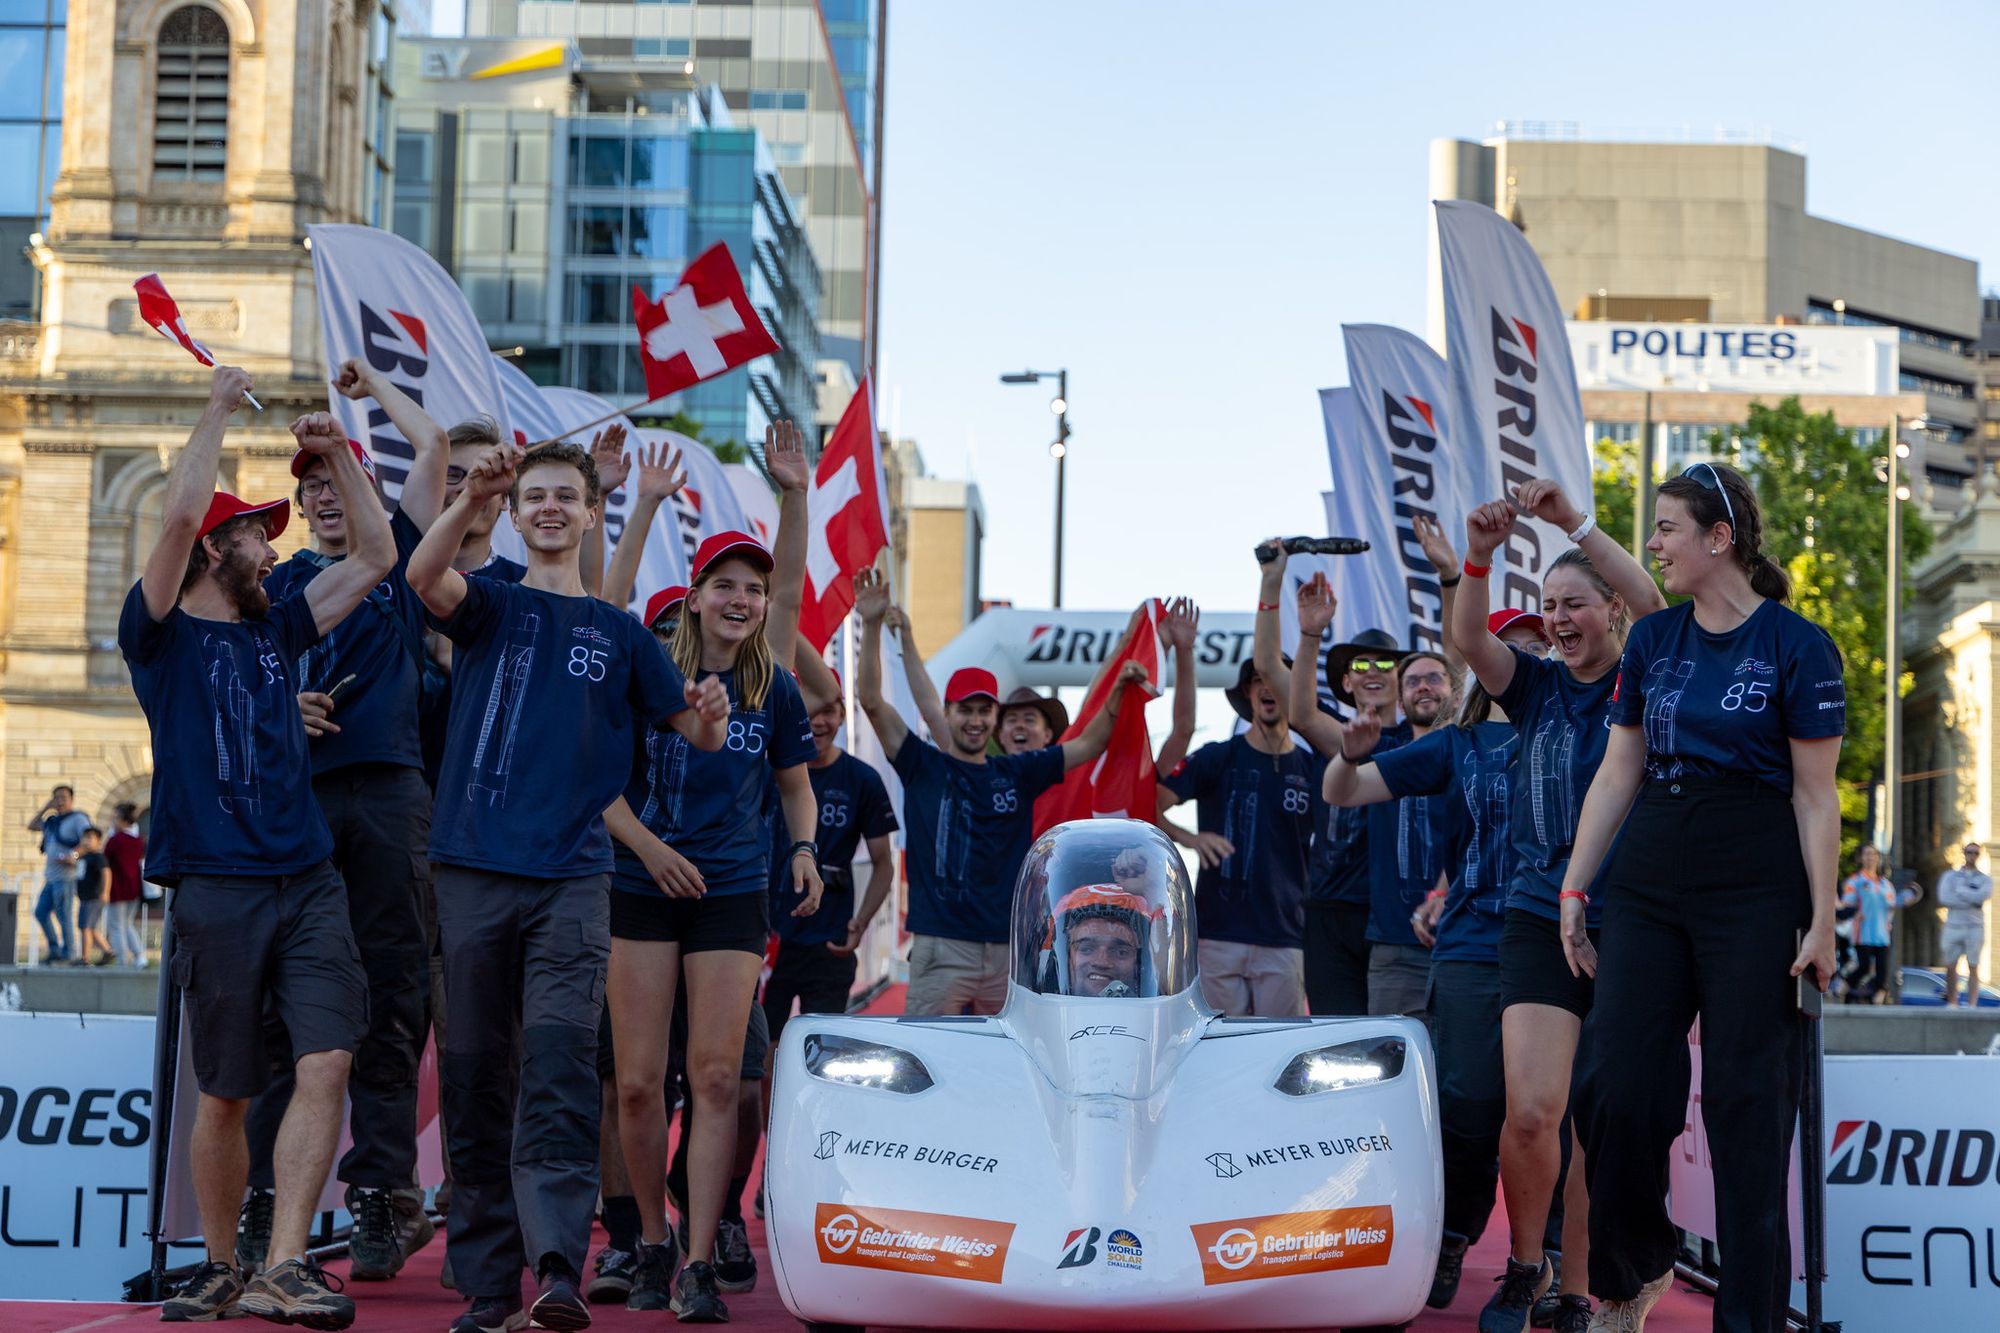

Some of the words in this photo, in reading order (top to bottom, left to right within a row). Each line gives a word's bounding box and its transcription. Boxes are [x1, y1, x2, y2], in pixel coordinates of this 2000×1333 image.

[420, 46, 470, 79] EY
[1611, 330, 1797, 360] POLITES
[568, 646, 608, 681] 85
[1721, 681, 1771, 712] 85
[726, 721, 765, 753] 85
[993, 788, 1017, 812] 85
[1283, 788, 1310, 814] 85
[821, 803, 848, 828] 85
[844, 1139, 909, 1159] MEYER
[914, 1147, 998, 1173] BURGER
[1246, 1144, 1315, 1168] MEYER
[1318, 1135, 1392, 1157] BURGER
[1826, 1120, 2000, 1187] BRID
[859, 1227, 939, 1251] Gebrüder
[940, 1235, 998, 1257] Weiss
[1107, 1244, 1142, 1257] WORLD
[1263, 1232, 1341, 1253] Gebrüder
[1345, 1227, 1386, 1246] Weiss
[856, 1247, 887, 1257] Transport
[887, 1250, 901, 1259] and
[902, 1251, 936, 1262] Logistics
[1107, 1252, 1142, 1264] SOLAR
[1107, 1261, 1142, 1271] CHALLENGE
[1262, 1254, 1297, 1265] Transport
[1299, 1252, 1312, 1261] and
[1314, 1250, 1344, 1261] Logistics
